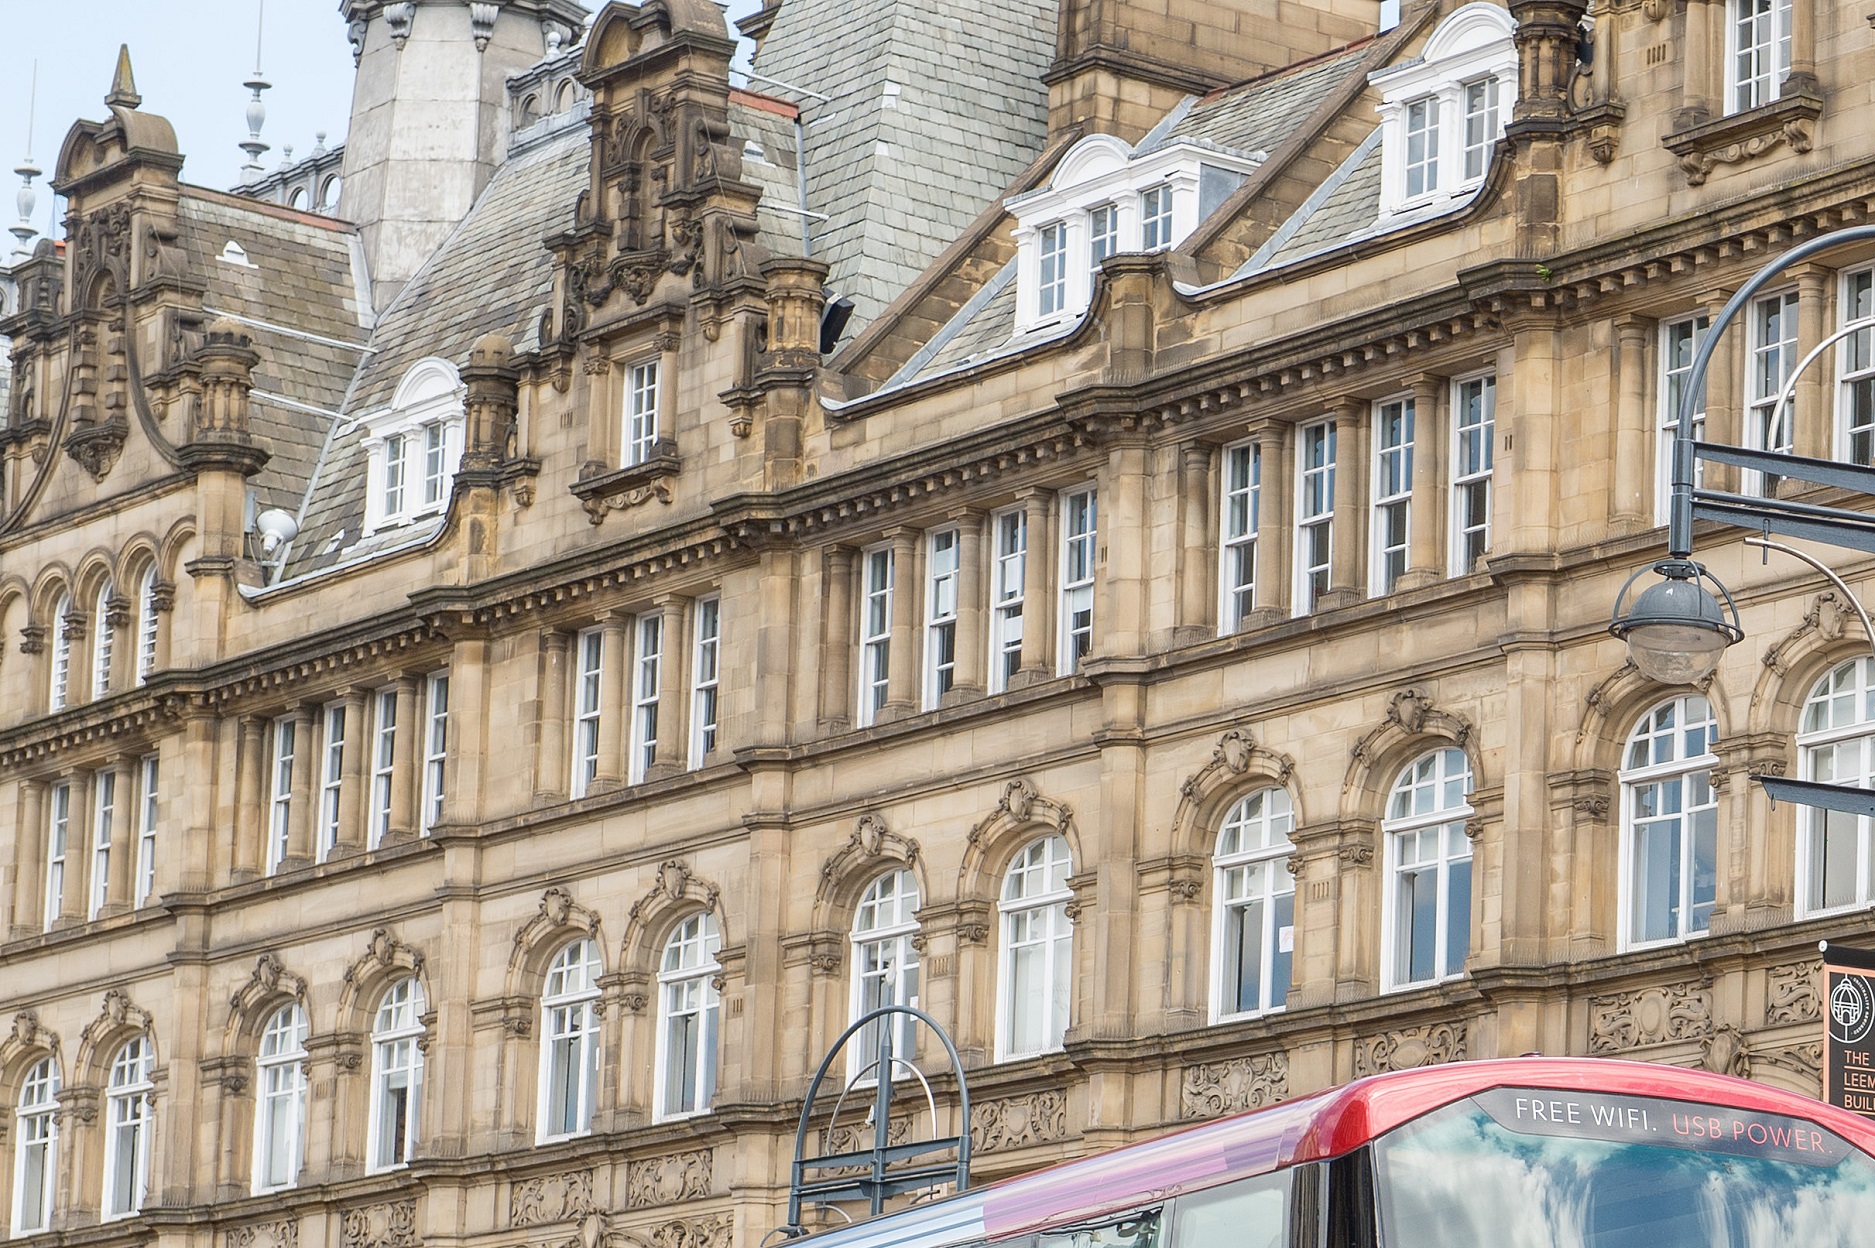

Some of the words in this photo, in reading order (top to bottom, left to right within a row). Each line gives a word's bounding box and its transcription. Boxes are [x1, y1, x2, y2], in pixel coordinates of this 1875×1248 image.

[1844, 1050, 1870, 1066] THE
[1515, 1097, 1581, 1125] FREE
[1590, 1104, 1657, 1132] WIFI.
[1672, 1112, 1723, 1139] USB
[1733, 1119, 1833, 1154] POWER.
